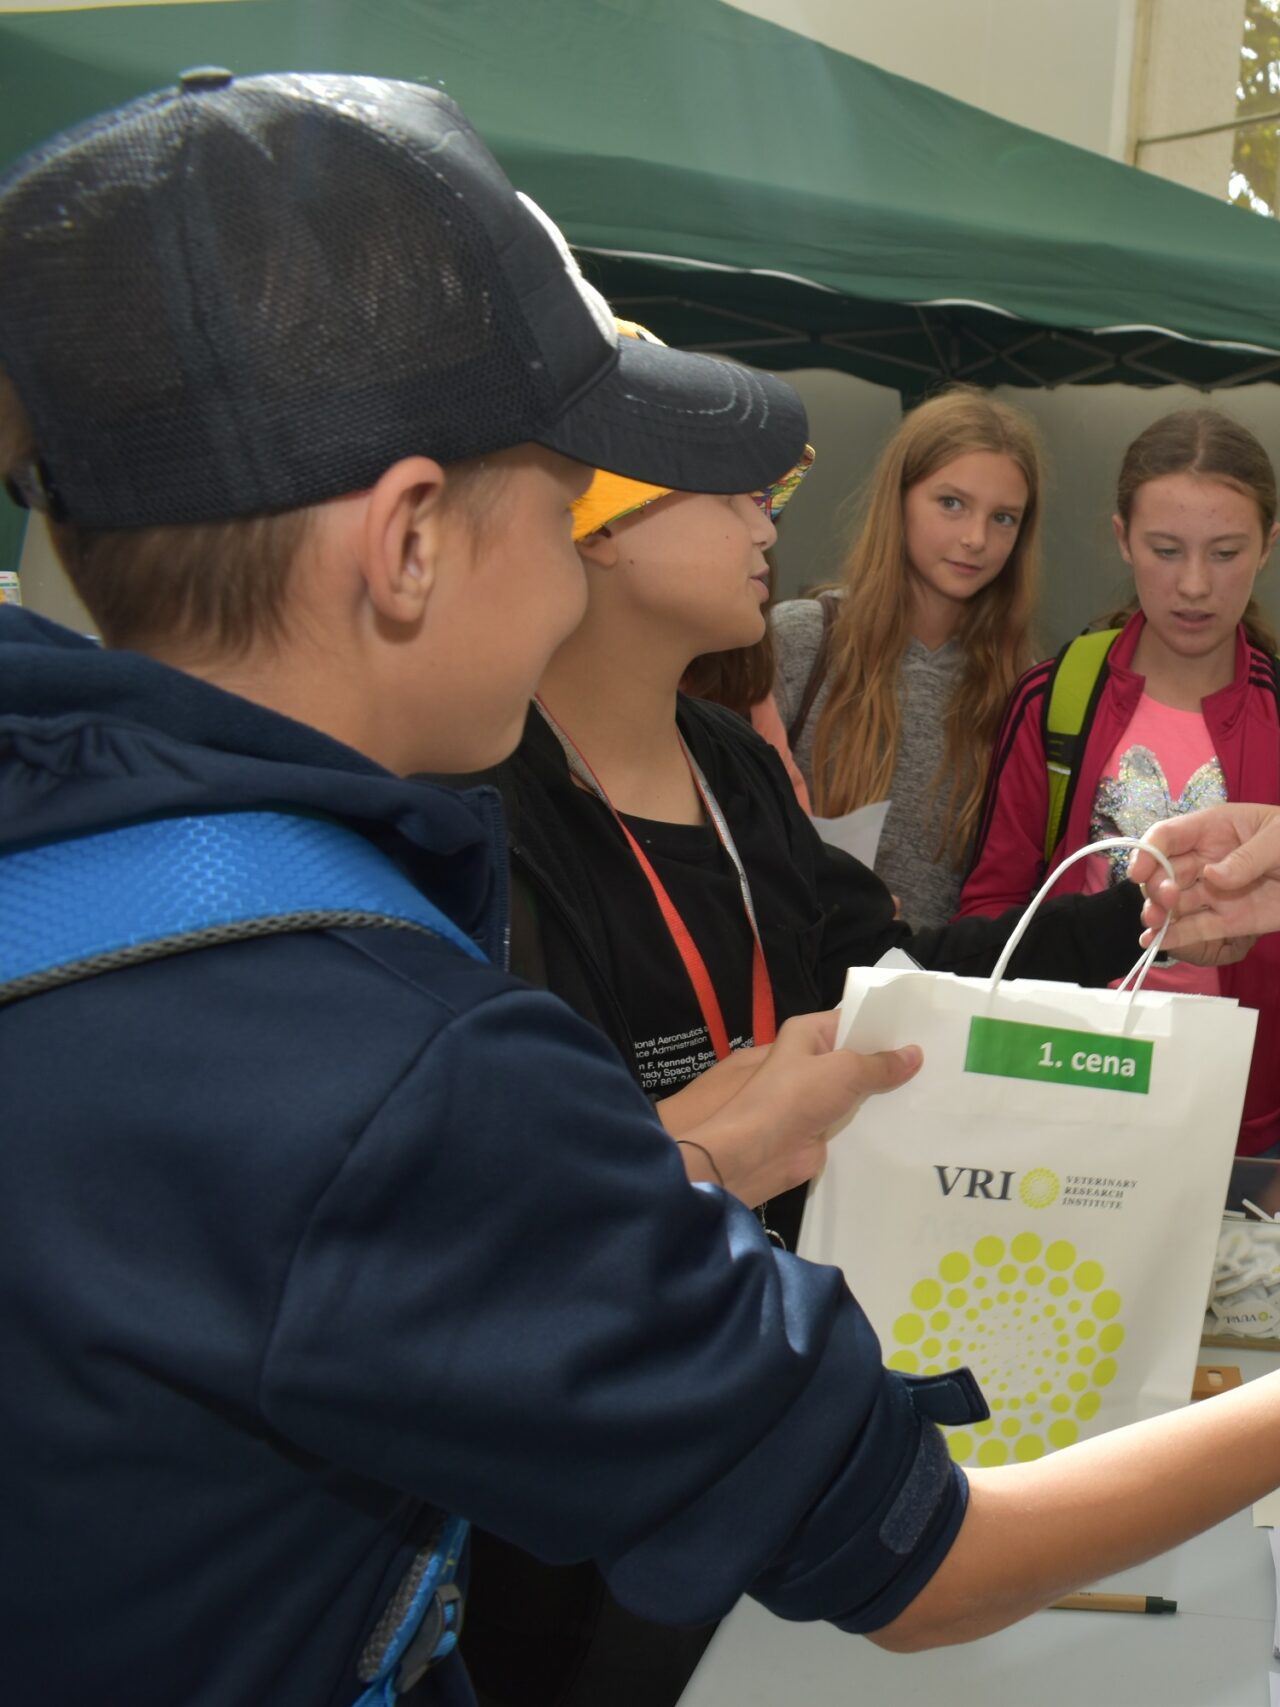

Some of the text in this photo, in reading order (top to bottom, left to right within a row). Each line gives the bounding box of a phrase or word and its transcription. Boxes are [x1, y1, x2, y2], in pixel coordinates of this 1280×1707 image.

[634, 1037, 656, 1049] ional
[657, 1026, 703, 1045] Aeronautics
[652, 1036, 707, 1055] Administration
[647, 1061, 656, 1070] F.
[657, 1055, 696, 1069] Kennedy
[1037, 1041, 1136, 1077] 1. cena
[664, 1065, 692, 1077] Space
[933, 1164, 1016, 1201] VRI
[1065, 1175, 1138, 1188] VETERINARY
[1063, 1186, 1124, 1199] RESEARCH
[1061, 1197, 1123, 1210] INSTITUTE
